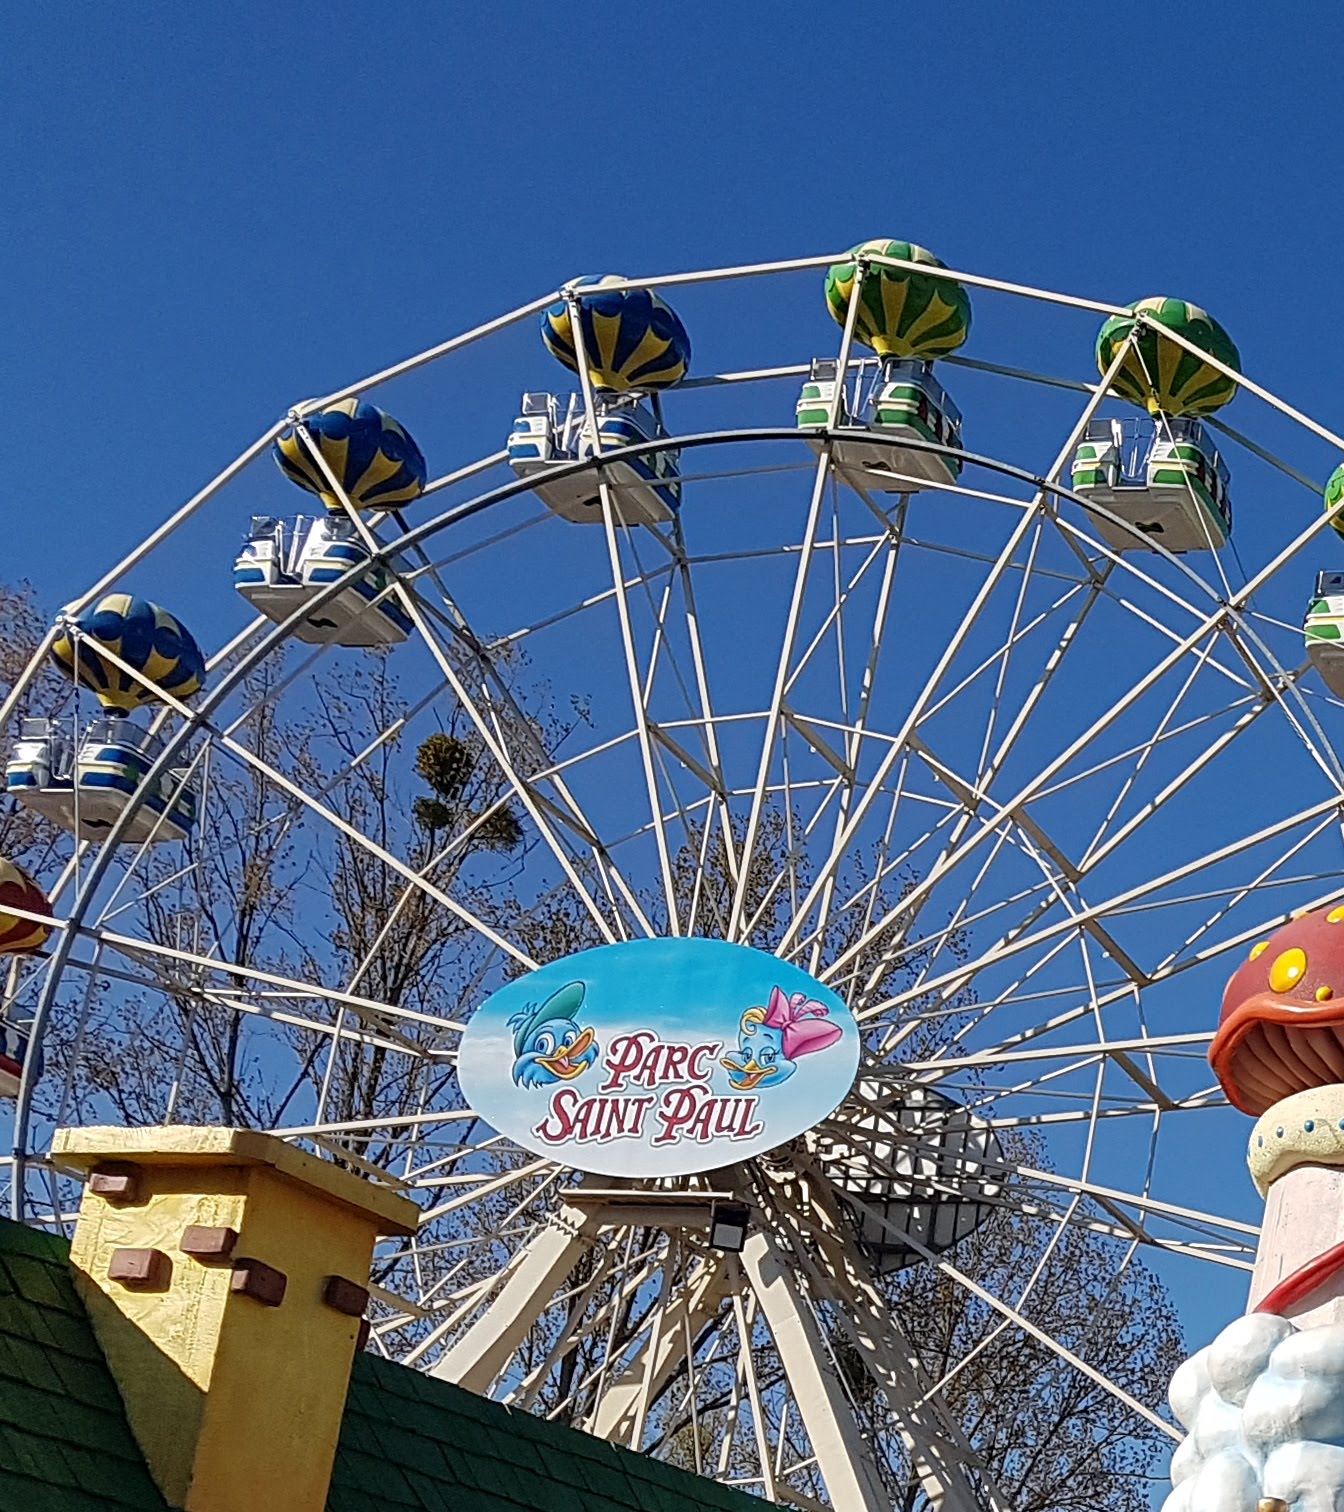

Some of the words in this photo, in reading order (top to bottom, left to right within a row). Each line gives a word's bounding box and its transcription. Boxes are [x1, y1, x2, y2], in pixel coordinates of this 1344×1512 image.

[601, 1031, 722, 1091] PARC
[534, 1087, 654, 1143] SAINT
[653, 1085, 763, 1145] PAUL
